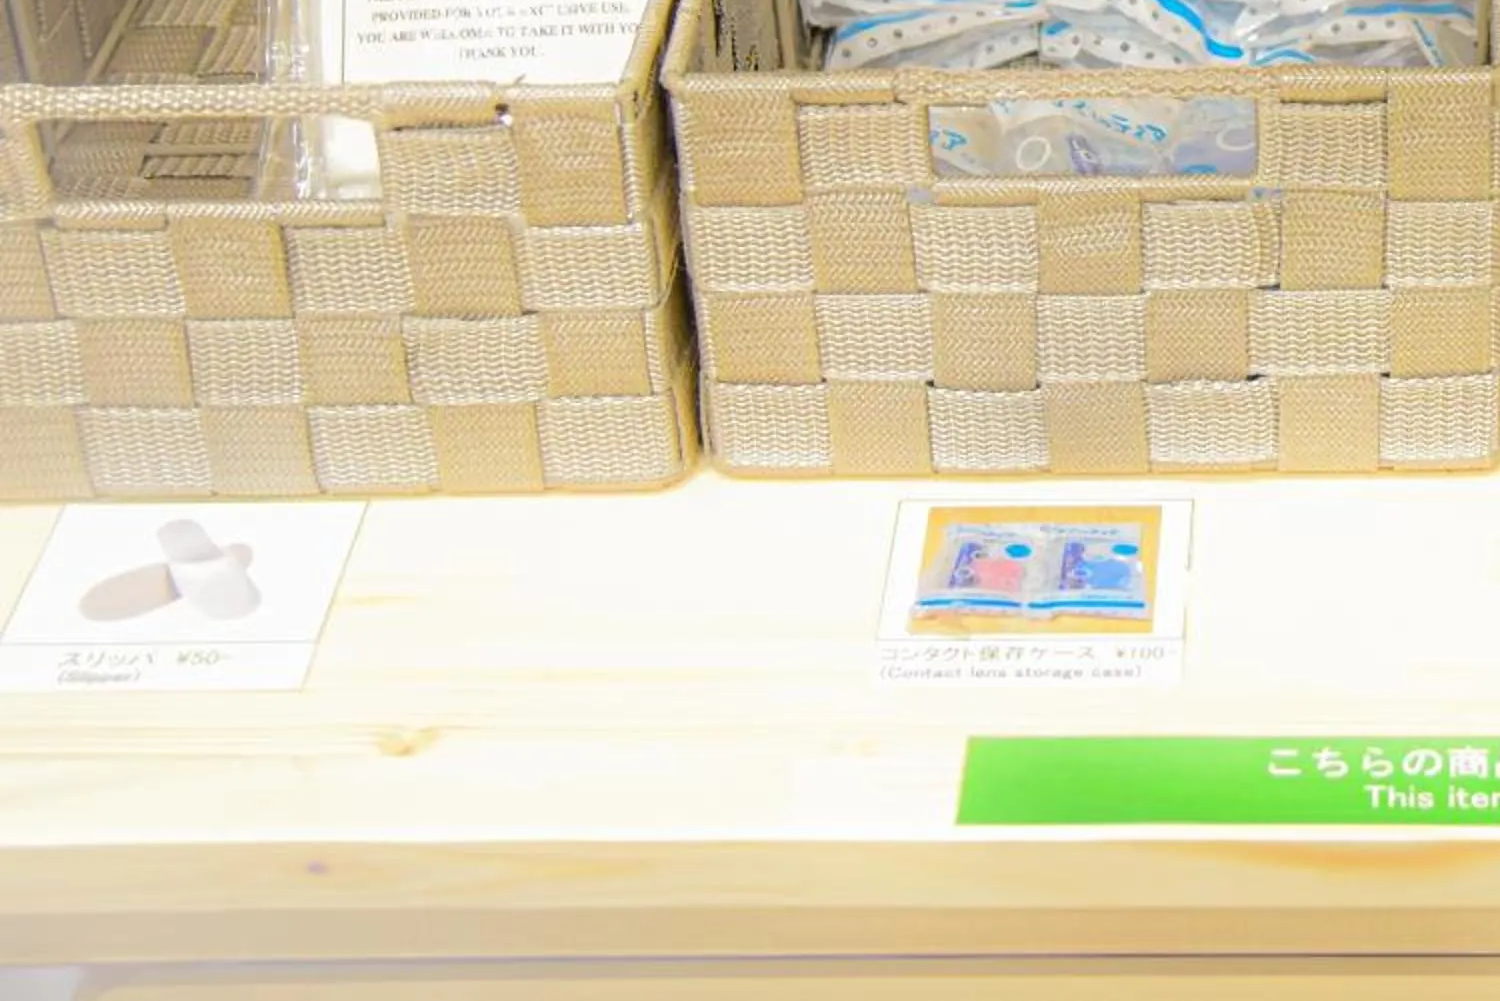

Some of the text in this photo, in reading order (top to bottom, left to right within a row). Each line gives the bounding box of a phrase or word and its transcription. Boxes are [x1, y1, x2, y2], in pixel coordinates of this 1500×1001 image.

[881, 645, 1095, 662] コンタクト保存ケース
[1364, 785, 1435, 809] This
